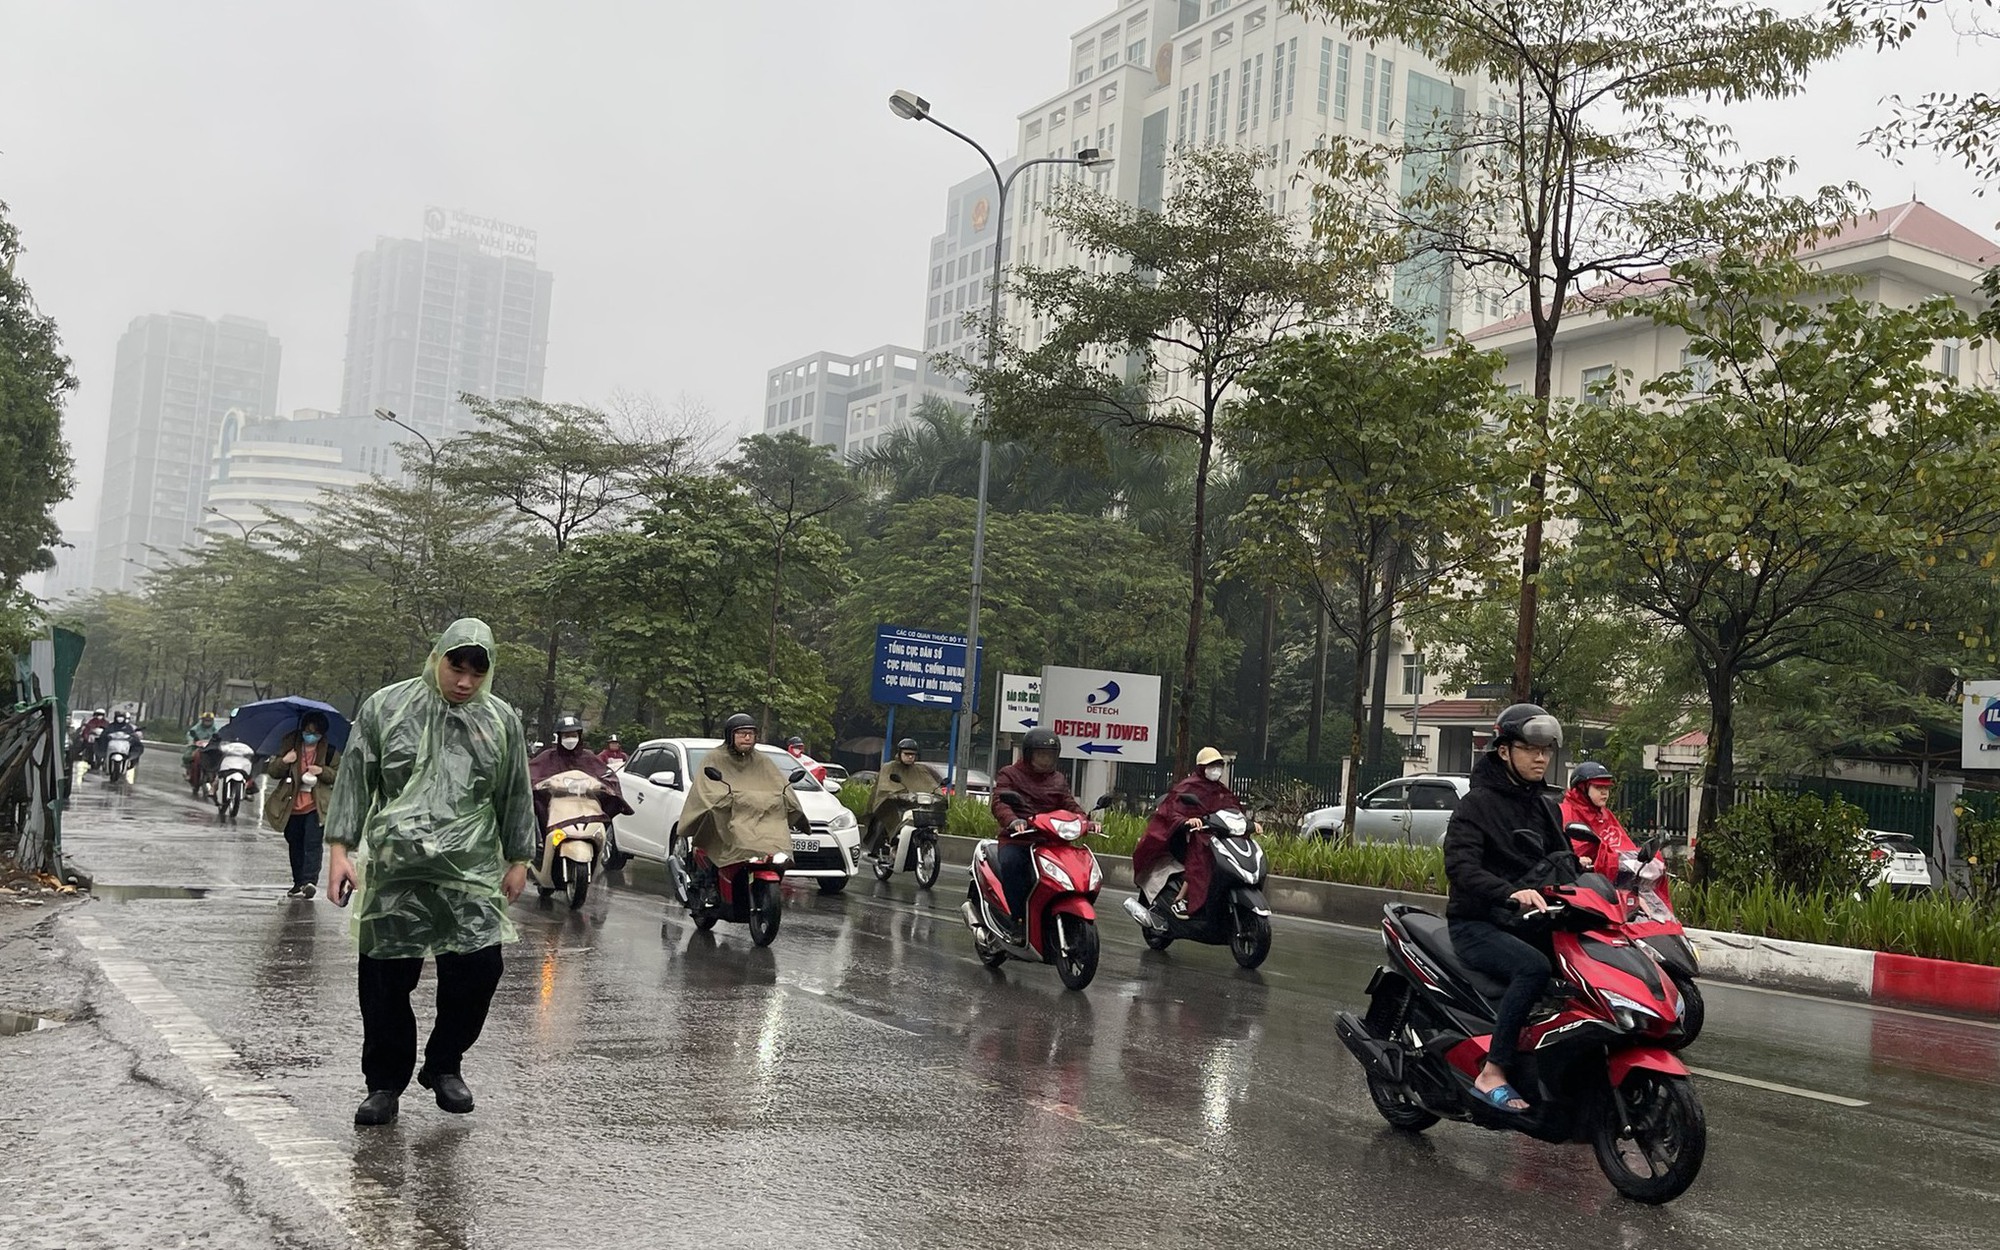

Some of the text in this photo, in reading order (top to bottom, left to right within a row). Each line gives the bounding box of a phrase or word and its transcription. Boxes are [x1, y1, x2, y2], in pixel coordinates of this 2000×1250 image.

[896, 628, 907, 636] CÁC
[932, 634, 948, 642] THUỘC
[888, 640, 943, 659] TỔNG CỤC DÂN SỐ
[886, 659, 900, 671] CỤC
[925, 662, 946, 675] CHỐNG
[885, 674, 962, 693] CỤC QUẢN LÝ MÔI TRƯỜNG
[1028, 682, 1037, 690] BỘ
[1086, 706, 1119, 715] DETECH
[1054, 719, 1149, 742] DETECH TOWER
